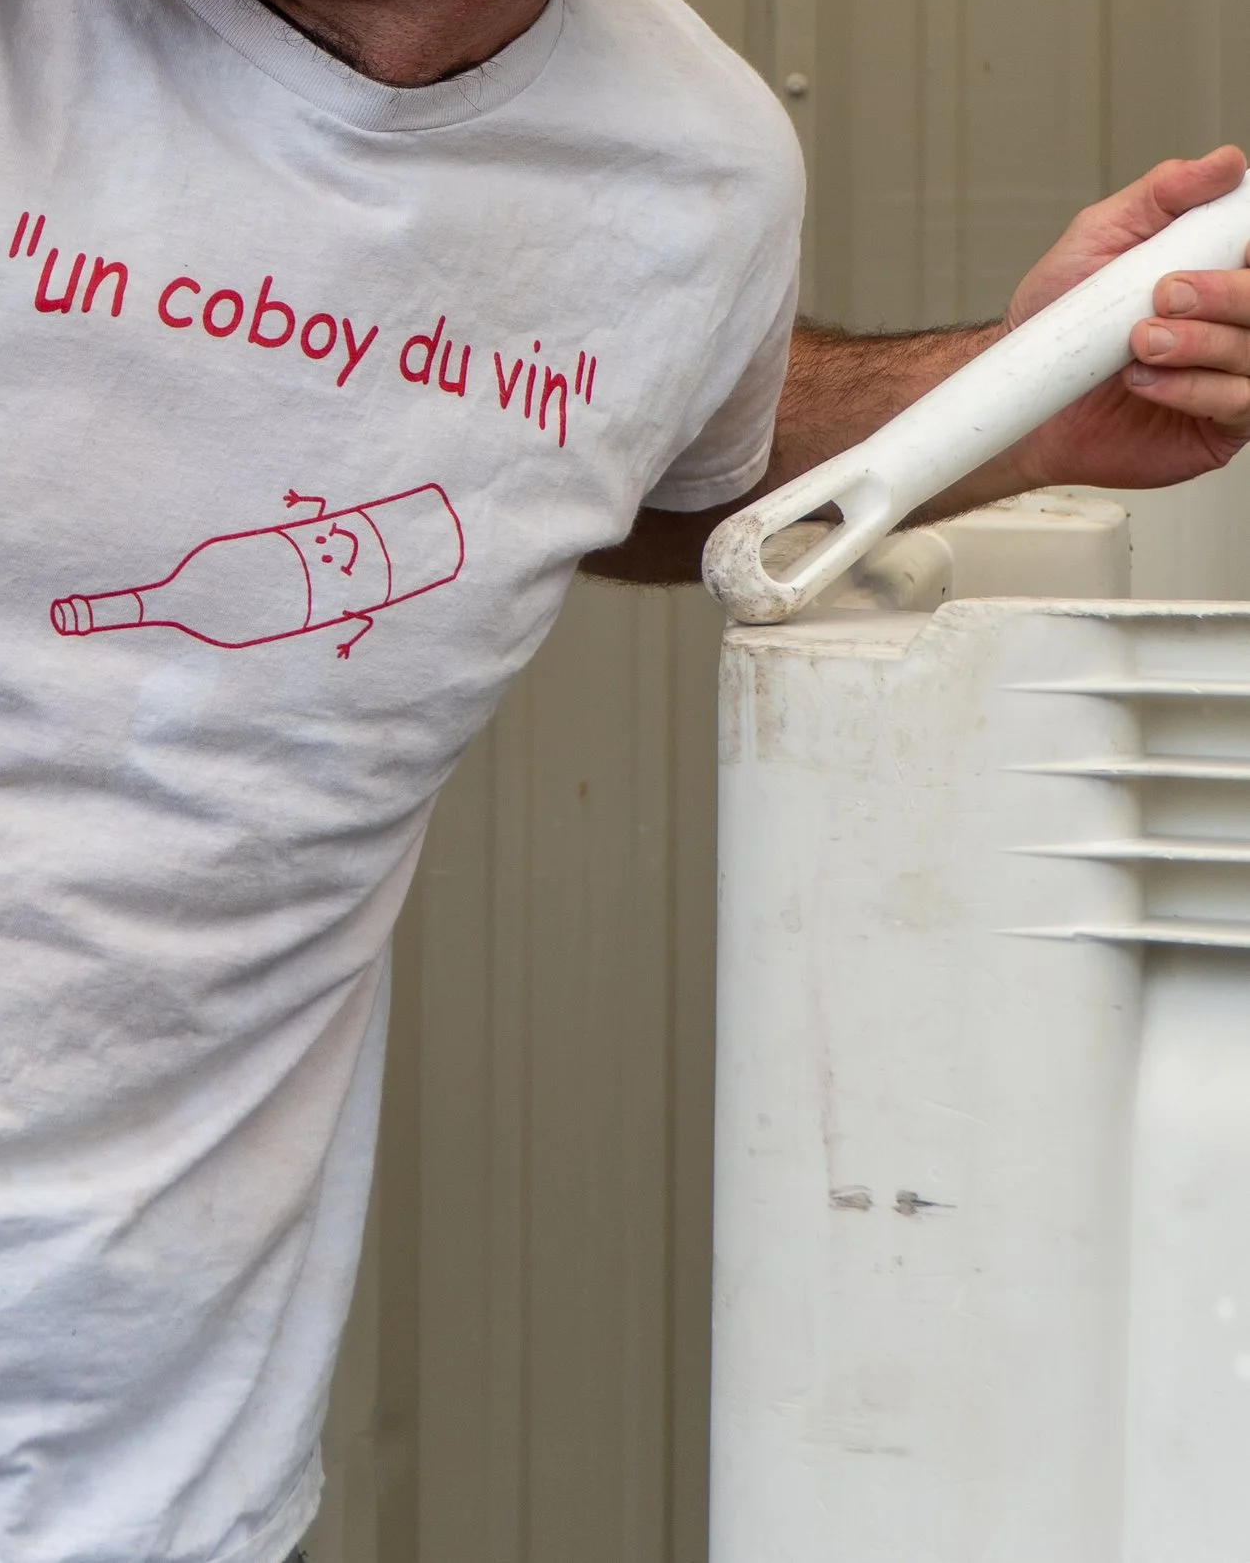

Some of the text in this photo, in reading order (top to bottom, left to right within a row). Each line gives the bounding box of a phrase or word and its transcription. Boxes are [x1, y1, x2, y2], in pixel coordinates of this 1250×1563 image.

[8, 211, 597, 447] "un coboy du vin"
